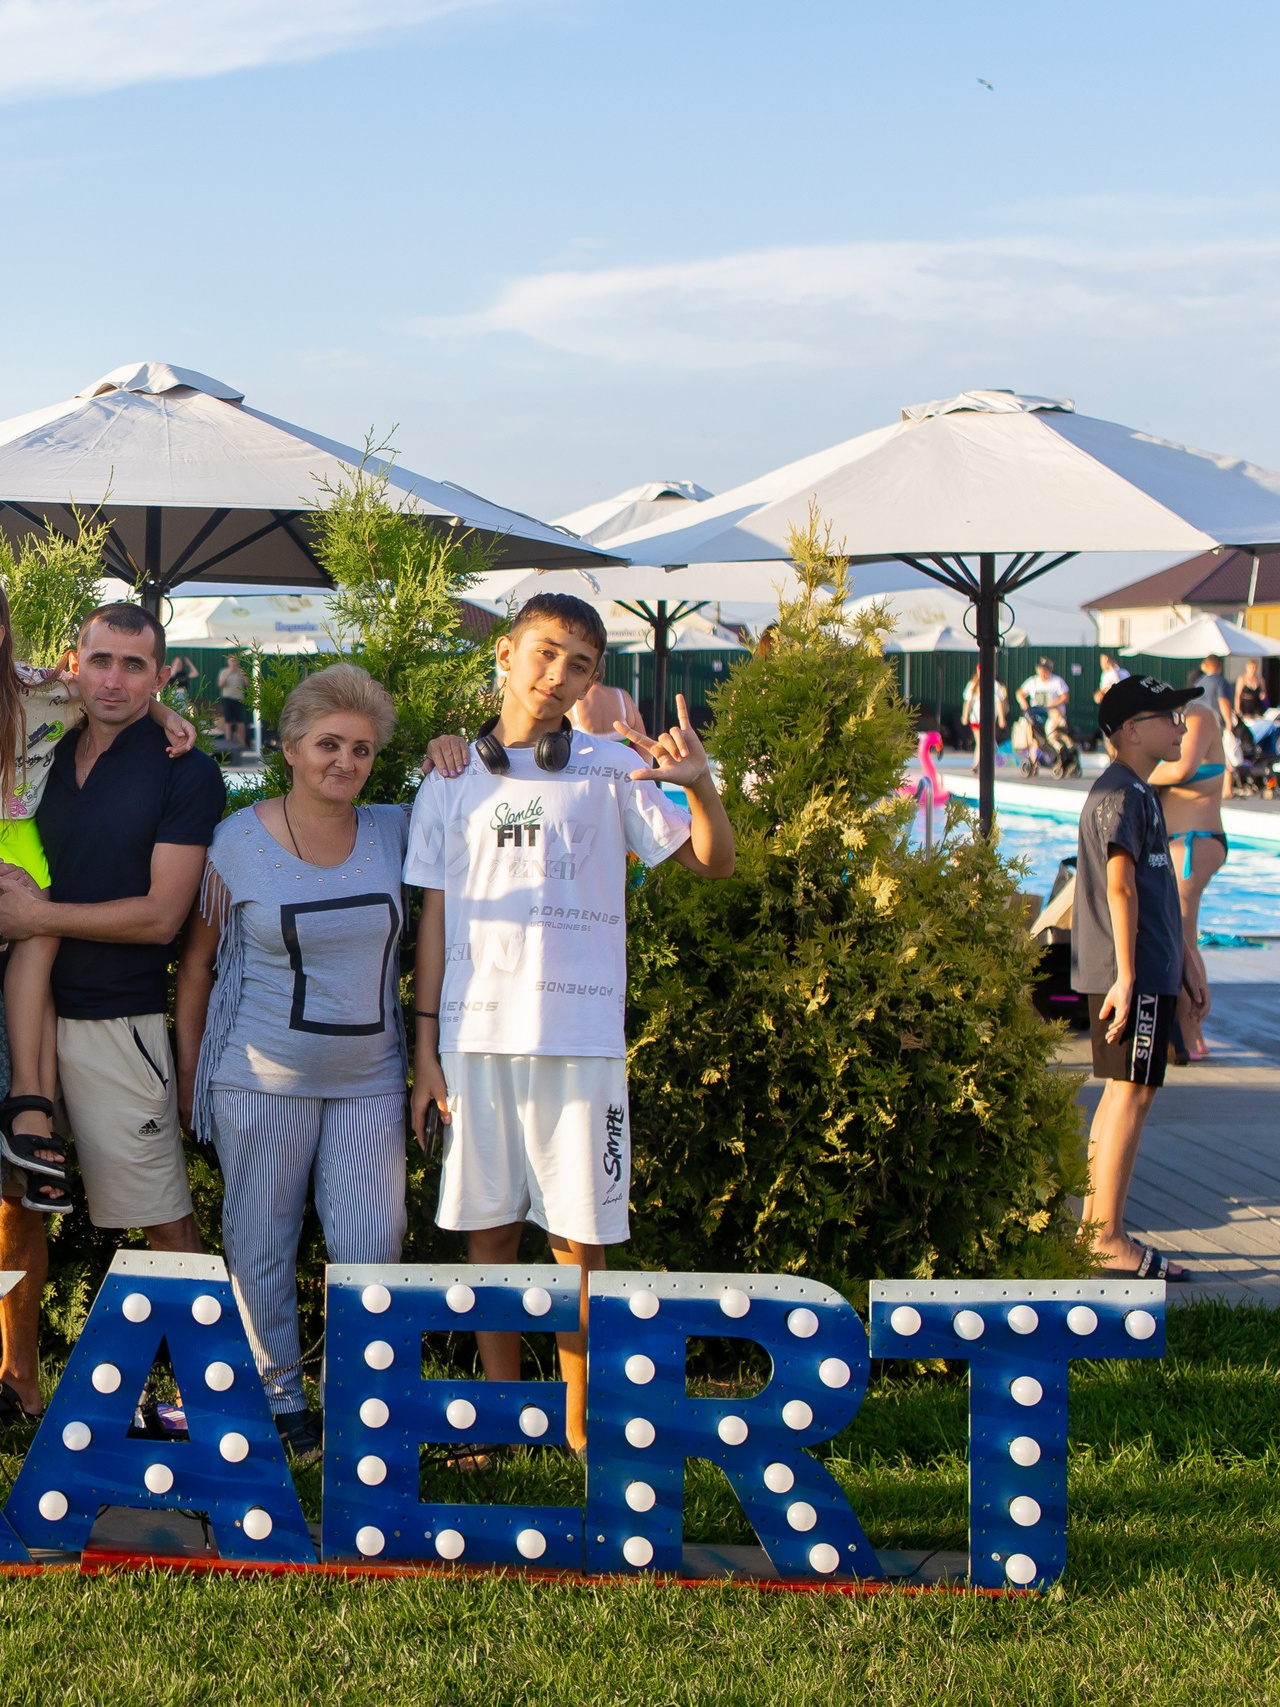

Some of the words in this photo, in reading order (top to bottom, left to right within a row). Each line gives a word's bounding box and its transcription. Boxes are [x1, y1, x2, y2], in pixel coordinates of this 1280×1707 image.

[497, 824, 541, 848] FIT
[529, 905, 621, 925] ADARENDS
[535, 980, 614, 998] ADARENDS
[1136, 1010, 1154, 1060] SURF
